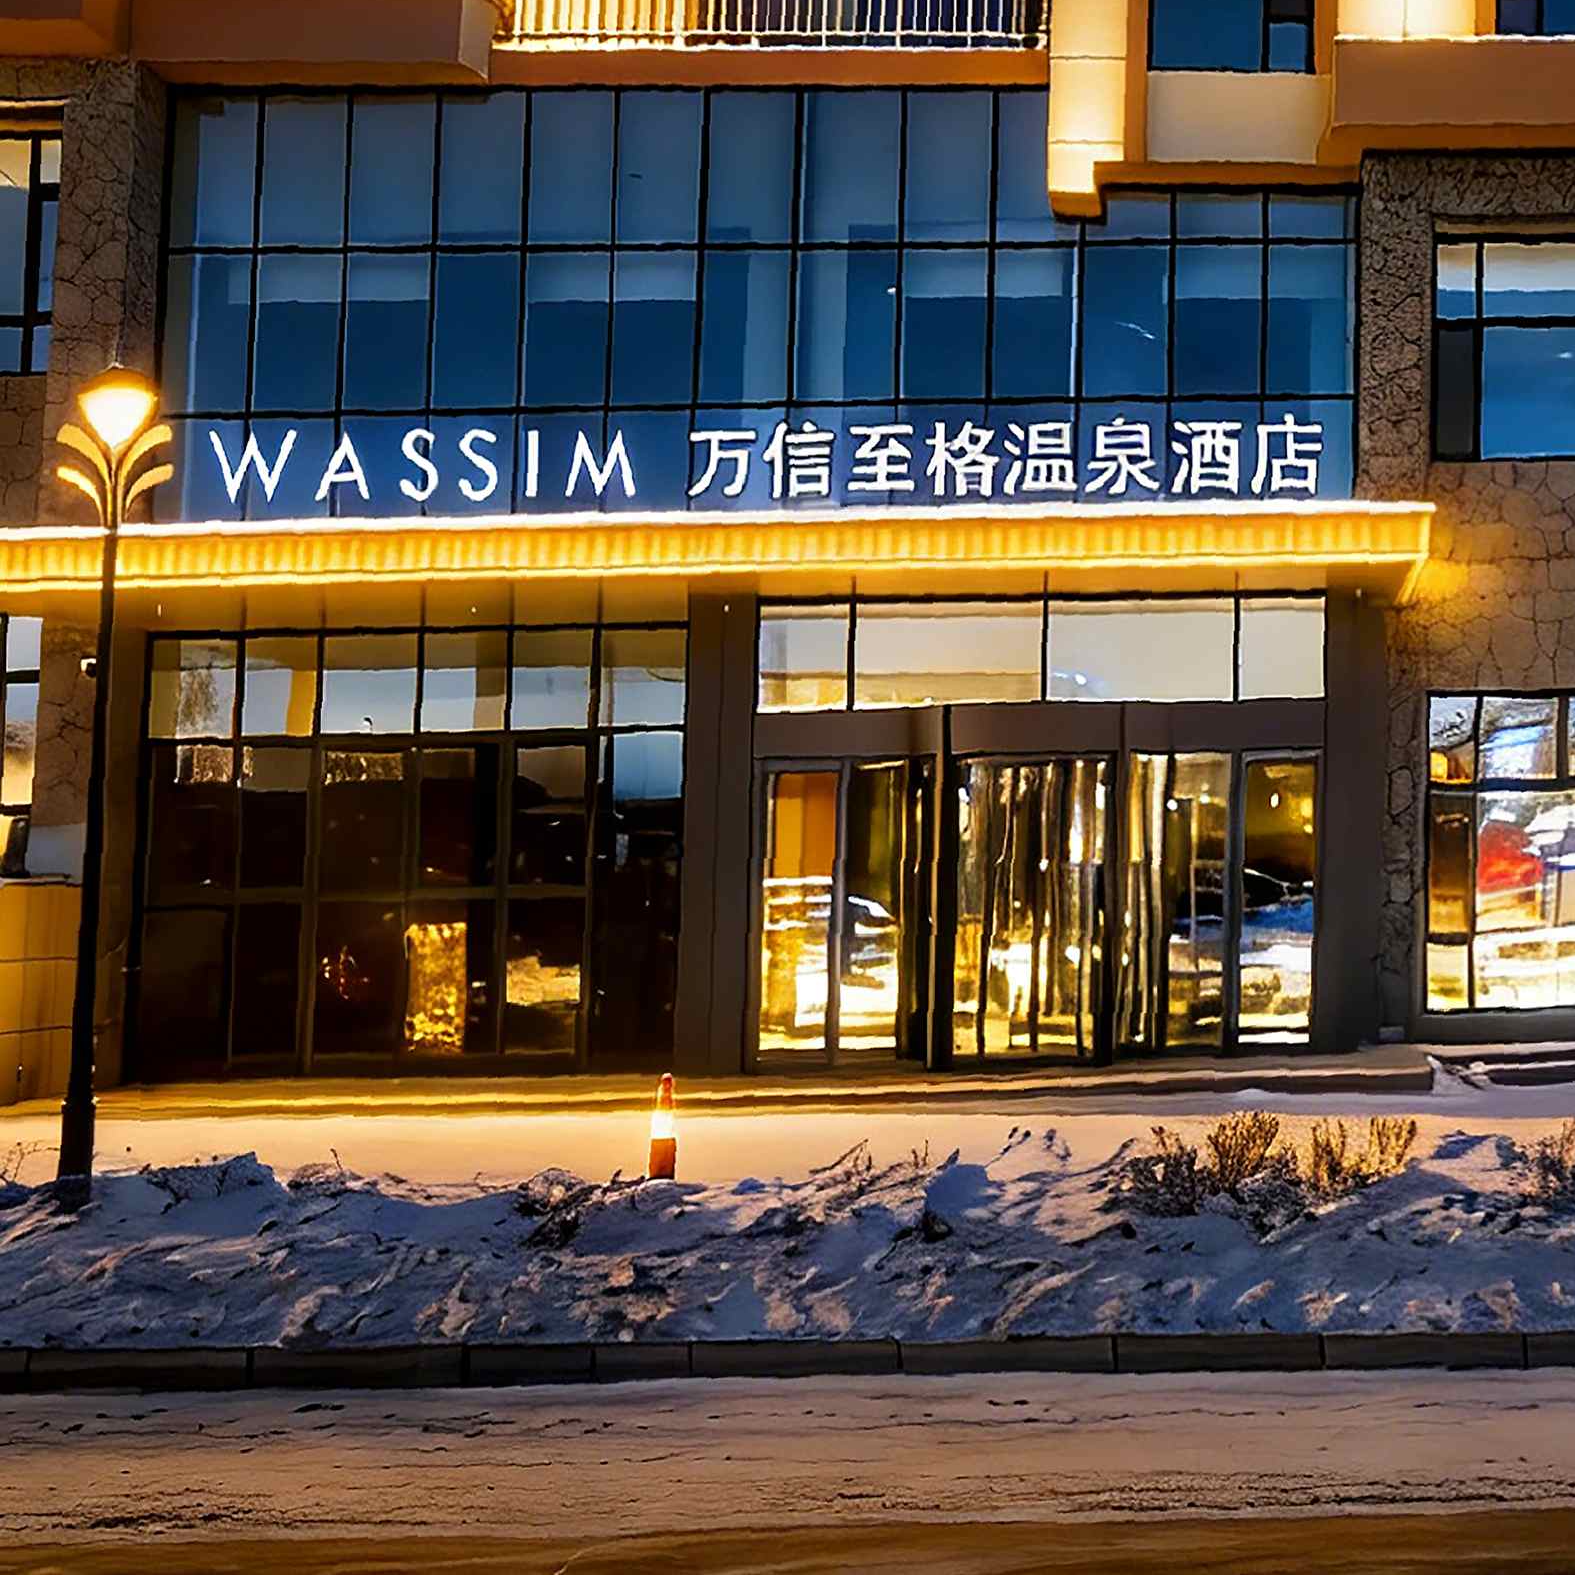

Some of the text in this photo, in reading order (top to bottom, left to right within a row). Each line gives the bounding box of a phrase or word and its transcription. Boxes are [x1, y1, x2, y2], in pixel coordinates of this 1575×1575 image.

[208, 427, 637, 504] WASSIM
[687, 413, 1324, 498] 万信至格温泉酒店
